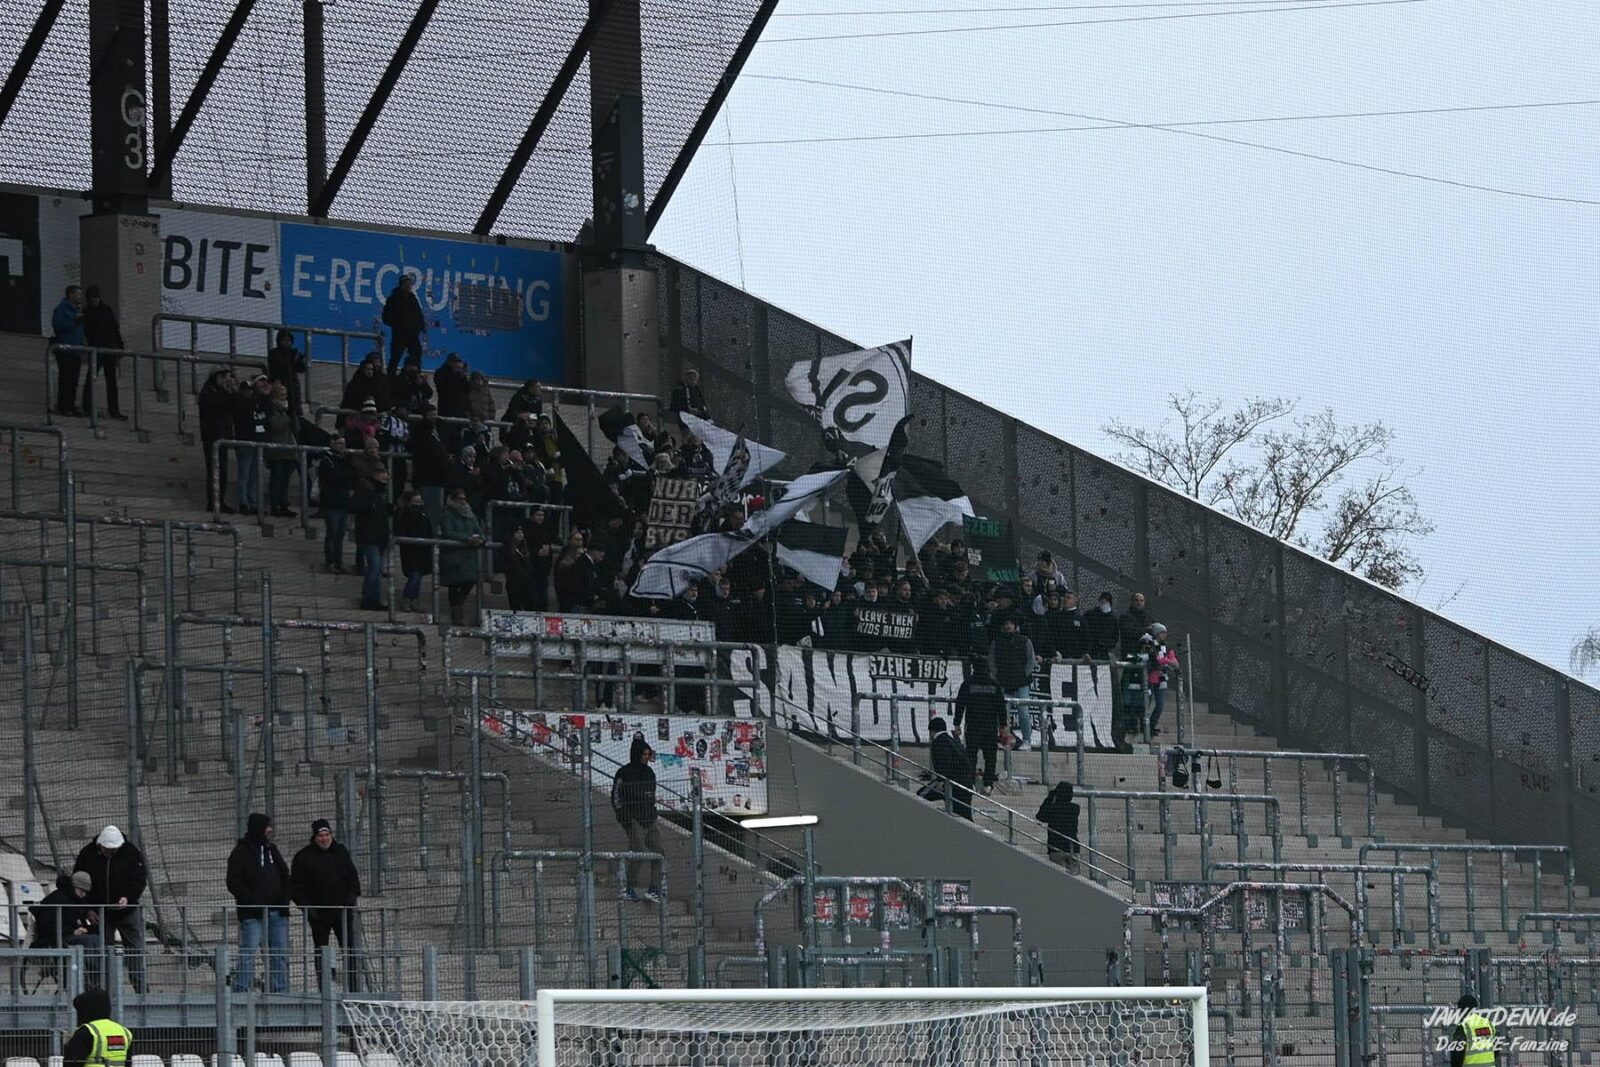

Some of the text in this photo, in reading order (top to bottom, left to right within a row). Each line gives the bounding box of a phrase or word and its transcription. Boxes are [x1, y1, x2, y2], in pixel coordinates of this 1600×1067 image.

[292, 253, 551, 322] E-RECRUITING
[653, 478, 697, 499] NUR
[649, 501, 693, 526] DER
[857, 622, 880, 636] KIDS
[860, 610, 914, 627] LEAVE THEM
[869, 655, 947, 680] SZENE 1916
